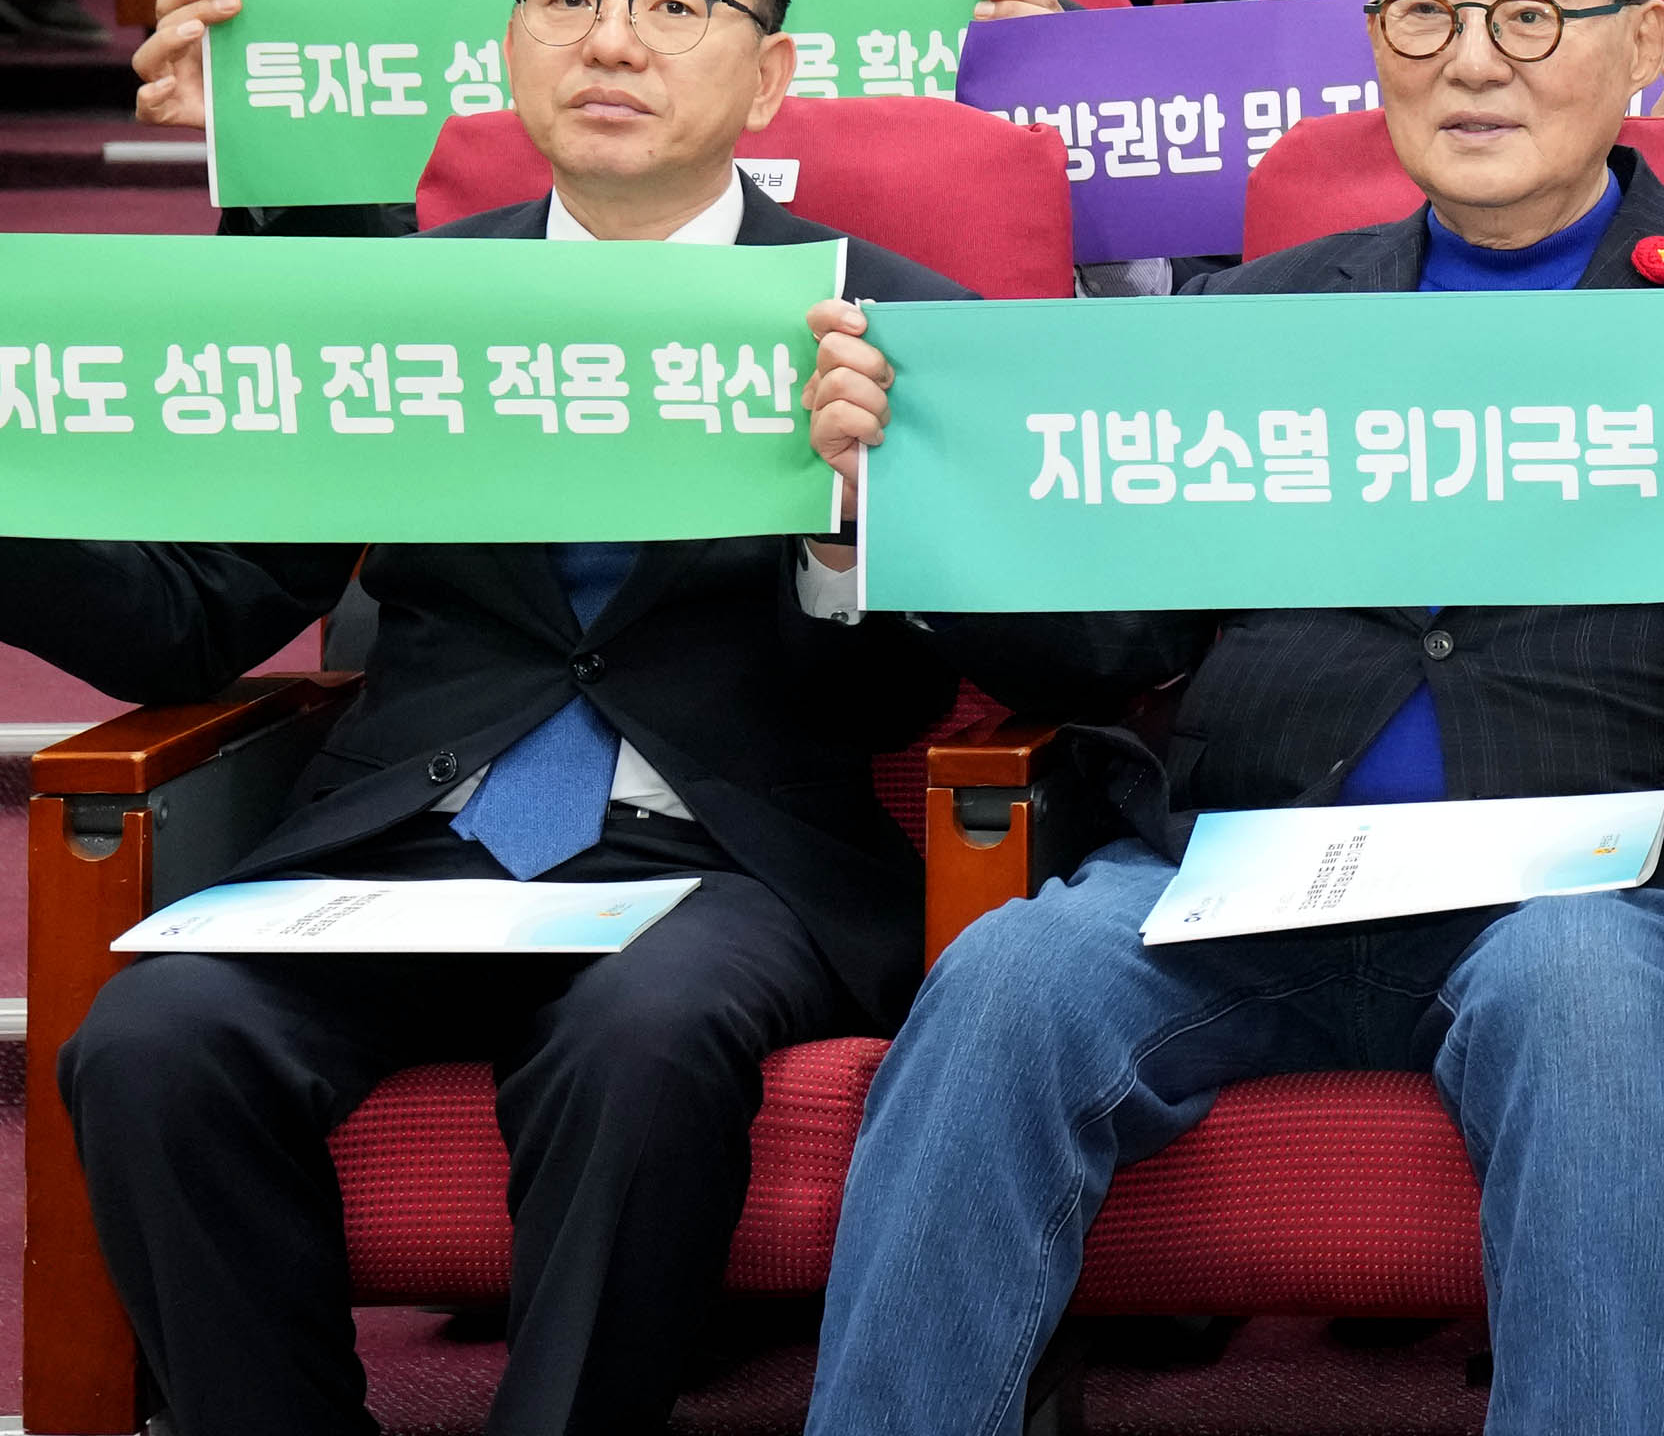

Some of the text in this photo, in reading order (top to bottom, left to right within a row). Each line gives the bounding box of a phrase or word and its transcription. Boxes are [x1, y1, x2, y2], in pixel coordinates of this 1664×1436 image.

[246, 42, 427, 118] 특자도
[989, 92, 1225, 183] 방권한
[155, 343, 302, 434] 성과
[320, 343, 464, 435] 전국
[486, 342, 630, 435] 적용
[651, 340, 797, 435] 확산
[1026, 402, 1659, 505] 지방소멸 위기극복
